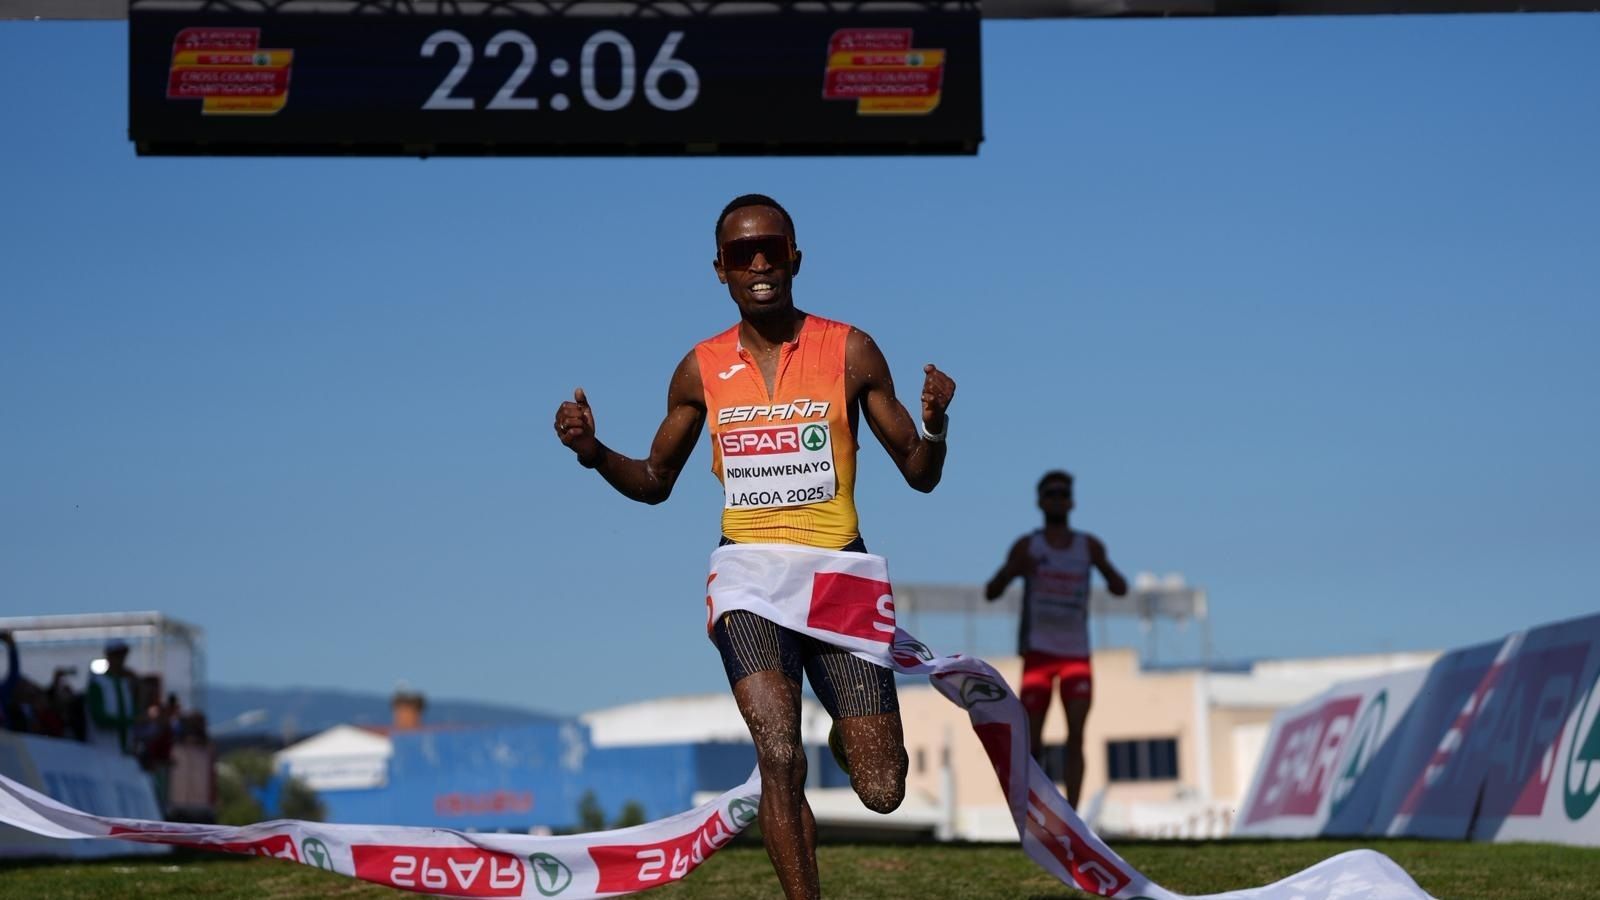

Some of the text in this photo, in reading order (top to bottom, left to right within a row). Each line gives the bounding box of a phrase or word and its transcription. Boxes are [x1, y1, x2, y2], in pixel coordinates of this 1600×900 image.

[420, 29, 700, 111] 22:06
[718, 398, 830, 425] ESPAÑA
[722, 431, 798, 453] SPAR
[727, 461, 831, 479] NDIKUMWENAYO
[730, 486, 825, 507] LAGOA 2025
